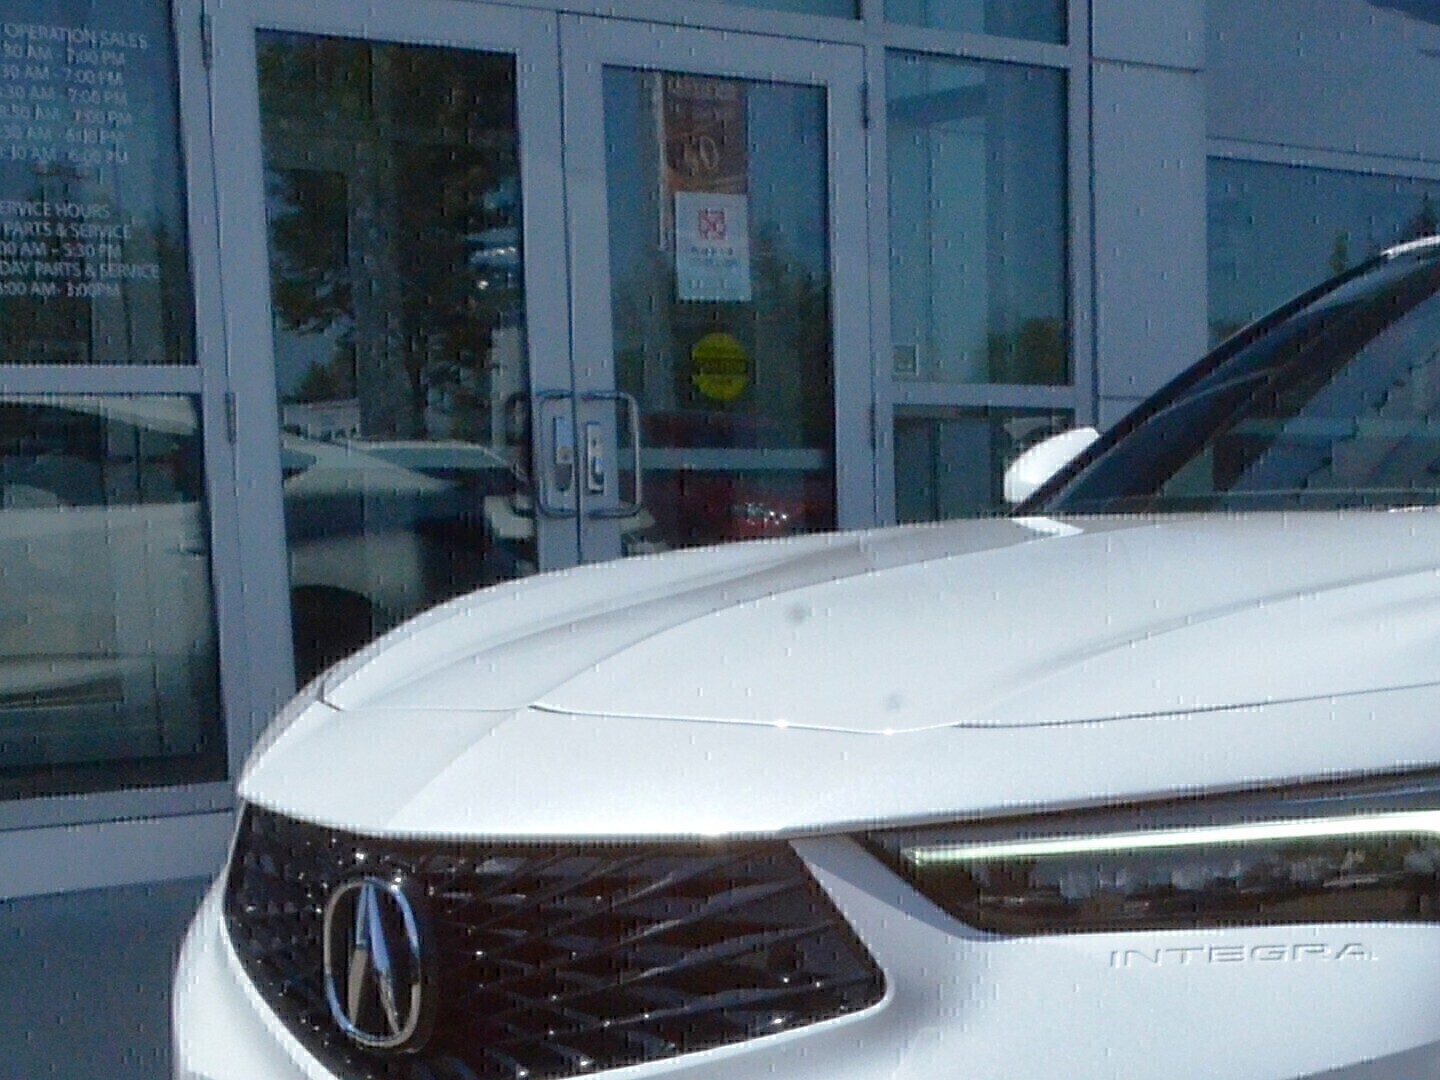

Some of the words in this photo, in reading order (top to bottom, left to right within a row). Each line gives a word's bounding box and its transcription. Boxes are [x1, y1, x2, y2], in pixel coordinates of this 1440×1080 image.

[4, 22, 97, 43] OPERATION
[100, 30, 148, 48] SALES
[55, 202, 110, 219] HOURS
[4, 221, 51, 238] PARTS
[56, 224, 67, 238] &
[69, 224, 132, 240] SERVICE
[21, 242, 47, 256] AM
[35, 260, 81, 277] PARTS
[100, 263, 159, 279] SERVICE
[1110, 942, 1378, 968] INTEGRA
